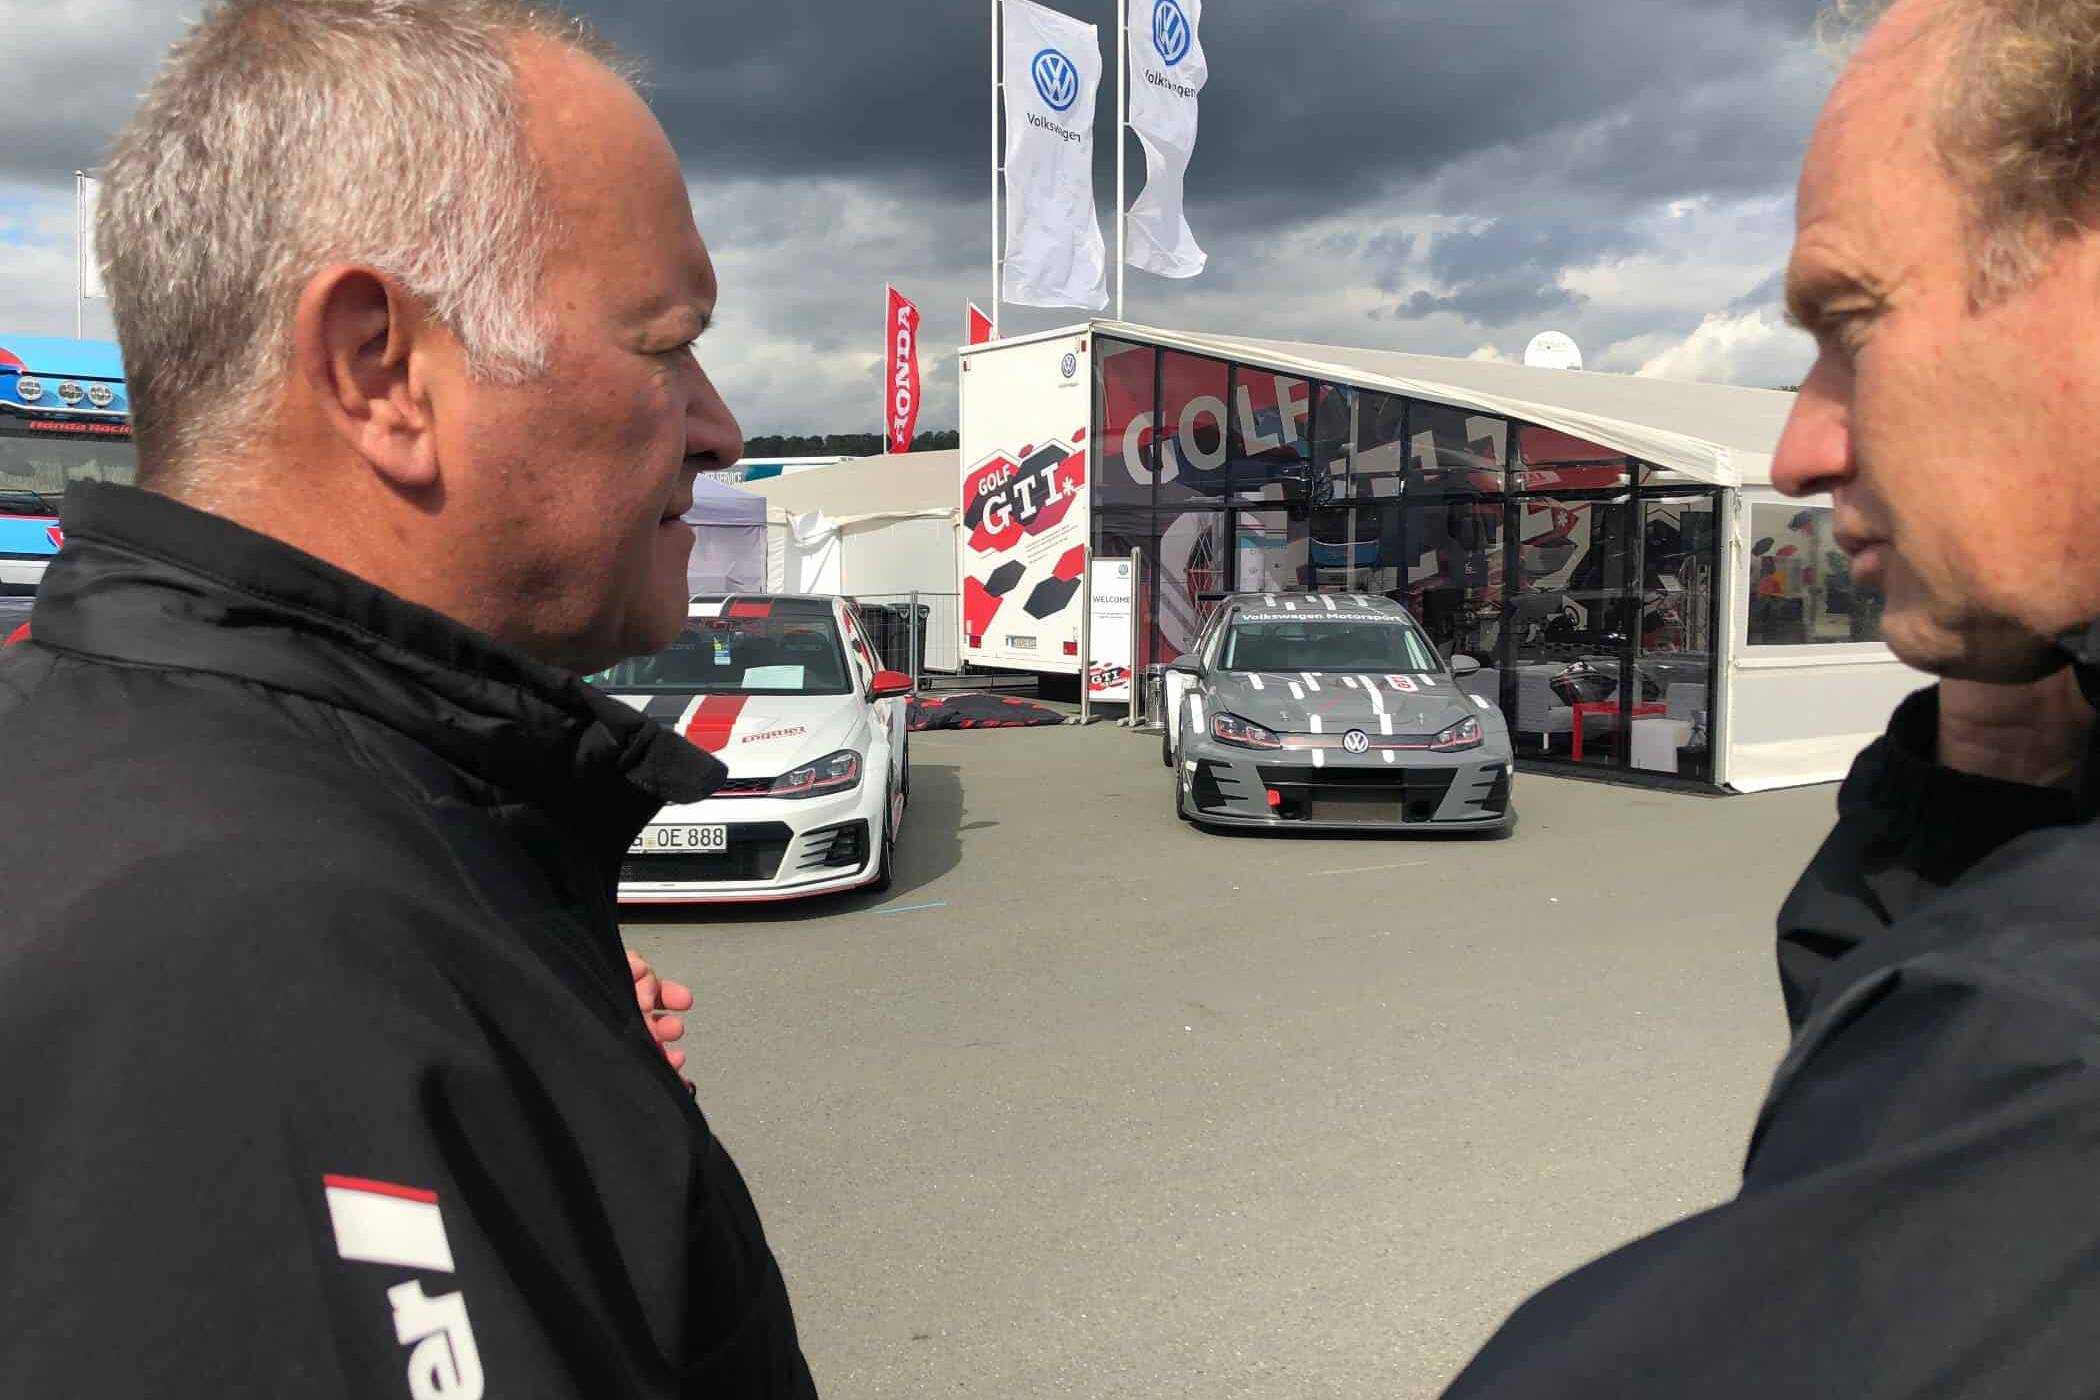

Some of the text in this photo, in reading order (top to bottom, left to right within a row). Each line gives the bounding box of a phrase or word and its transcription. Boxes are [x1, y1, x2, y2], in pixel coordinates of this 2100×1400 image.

[894, 306, 911, 444] HONDA
[29, 421, 86, 432] Honda
[1122, 376, 1309, 485] GOLF
[978, 463, 1011, 496] GOLF
[1092, 594, 1130, 604] WELCOME
[1242, 612, 1401, 622] Volkswagen Motorsport
[688, 827, 724, 847] 888
